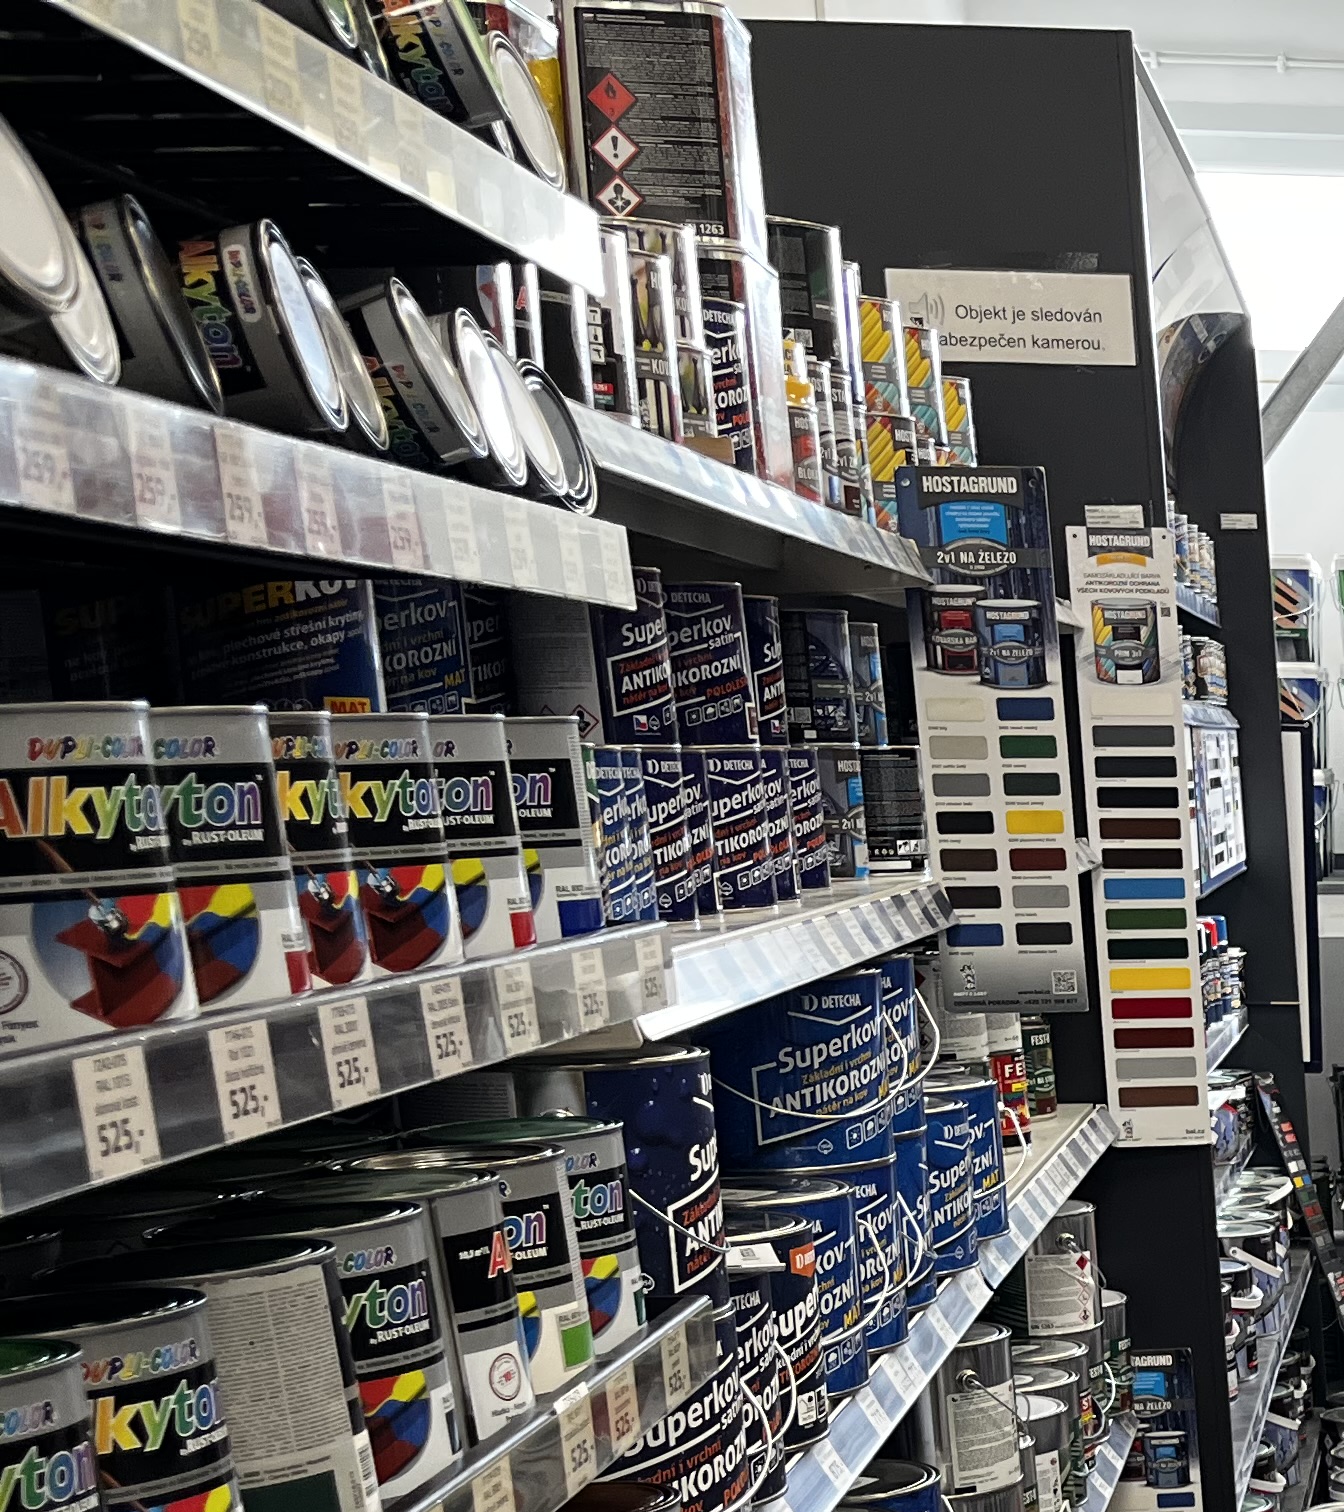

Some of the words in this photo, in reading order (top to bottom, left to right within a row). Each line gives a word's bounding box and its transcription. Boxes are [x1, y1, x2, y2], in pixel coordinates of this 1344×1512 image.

[955, 304, 1007, 323] Objekt
[1012, 305, 1025, 324] je
[1031, 307, 1102, 323] sledován
[936, 333, 1026, 350] abezpečen
[922, 476, 1017, 493] HOSTAGRUND
[1089, 534, 1150, 547] HOSTAGRUND
[937, 551, 955, 564] 2v1
[960, 551, 974, 564] NA
[978, 549, 1016, 564] ŽELEZO
[709, 632, 734, 650] satin
[444, 671, 465, 689] MAT
[192, 828, 264, 844] RUST-OLEUM
[821, 993, 861, 1009] DETECHA
[335, 1056, 369, 1089] 525,-
[229, 1084, 268, 1120] 525,-
[97, 1117, 144, 1157] 525,-
[982, 1169, 999, 1191] MAT
